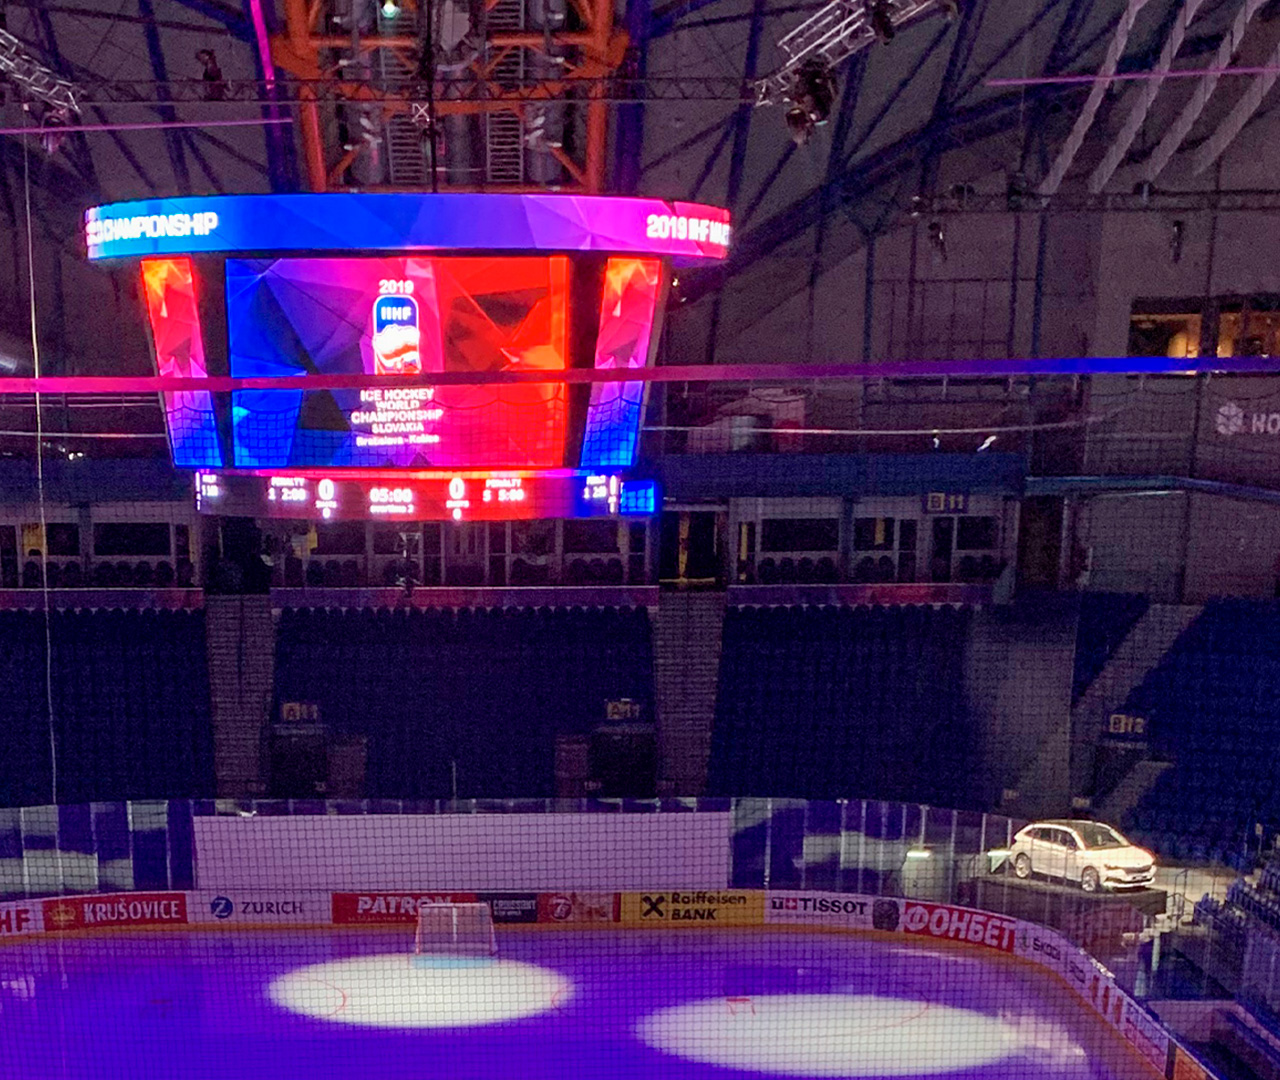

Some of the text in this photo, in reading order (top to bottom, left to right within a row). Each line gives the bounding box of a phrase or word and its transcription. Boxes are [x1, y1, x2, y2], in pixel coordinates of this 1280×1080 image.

[646, 214, 687, 240] 2019
[378, 279, 414, 294] 2019
[381, 306, 412, 320] IIHF
[360, 388, 434, 402] ICE HOCKEY
[375, 400, 420, 410] WORLD
[351, 409, 443, 423] CHAMPIONSHIP
[371, 422, 425, 434] SLOVAKIA
[271, 477, 305, 486] PENALTY
[448, 477, 465, 500] 0
[486, 479, 522, 488] PENALTY
[318, 478, 335, 501] 0
[369, 488, 413, 502] 05:00
[671, 891, 747, 905] Raiffeisen
[83, 897, 181, 924] KRUŠOVICE
[242, 901, 303, 915] ZURICH
[798, 897, 868, 915] TISSOT
[671, 908, 716, 920] BANK
[905, 905, 1016, 950] ФОНБЕТ
